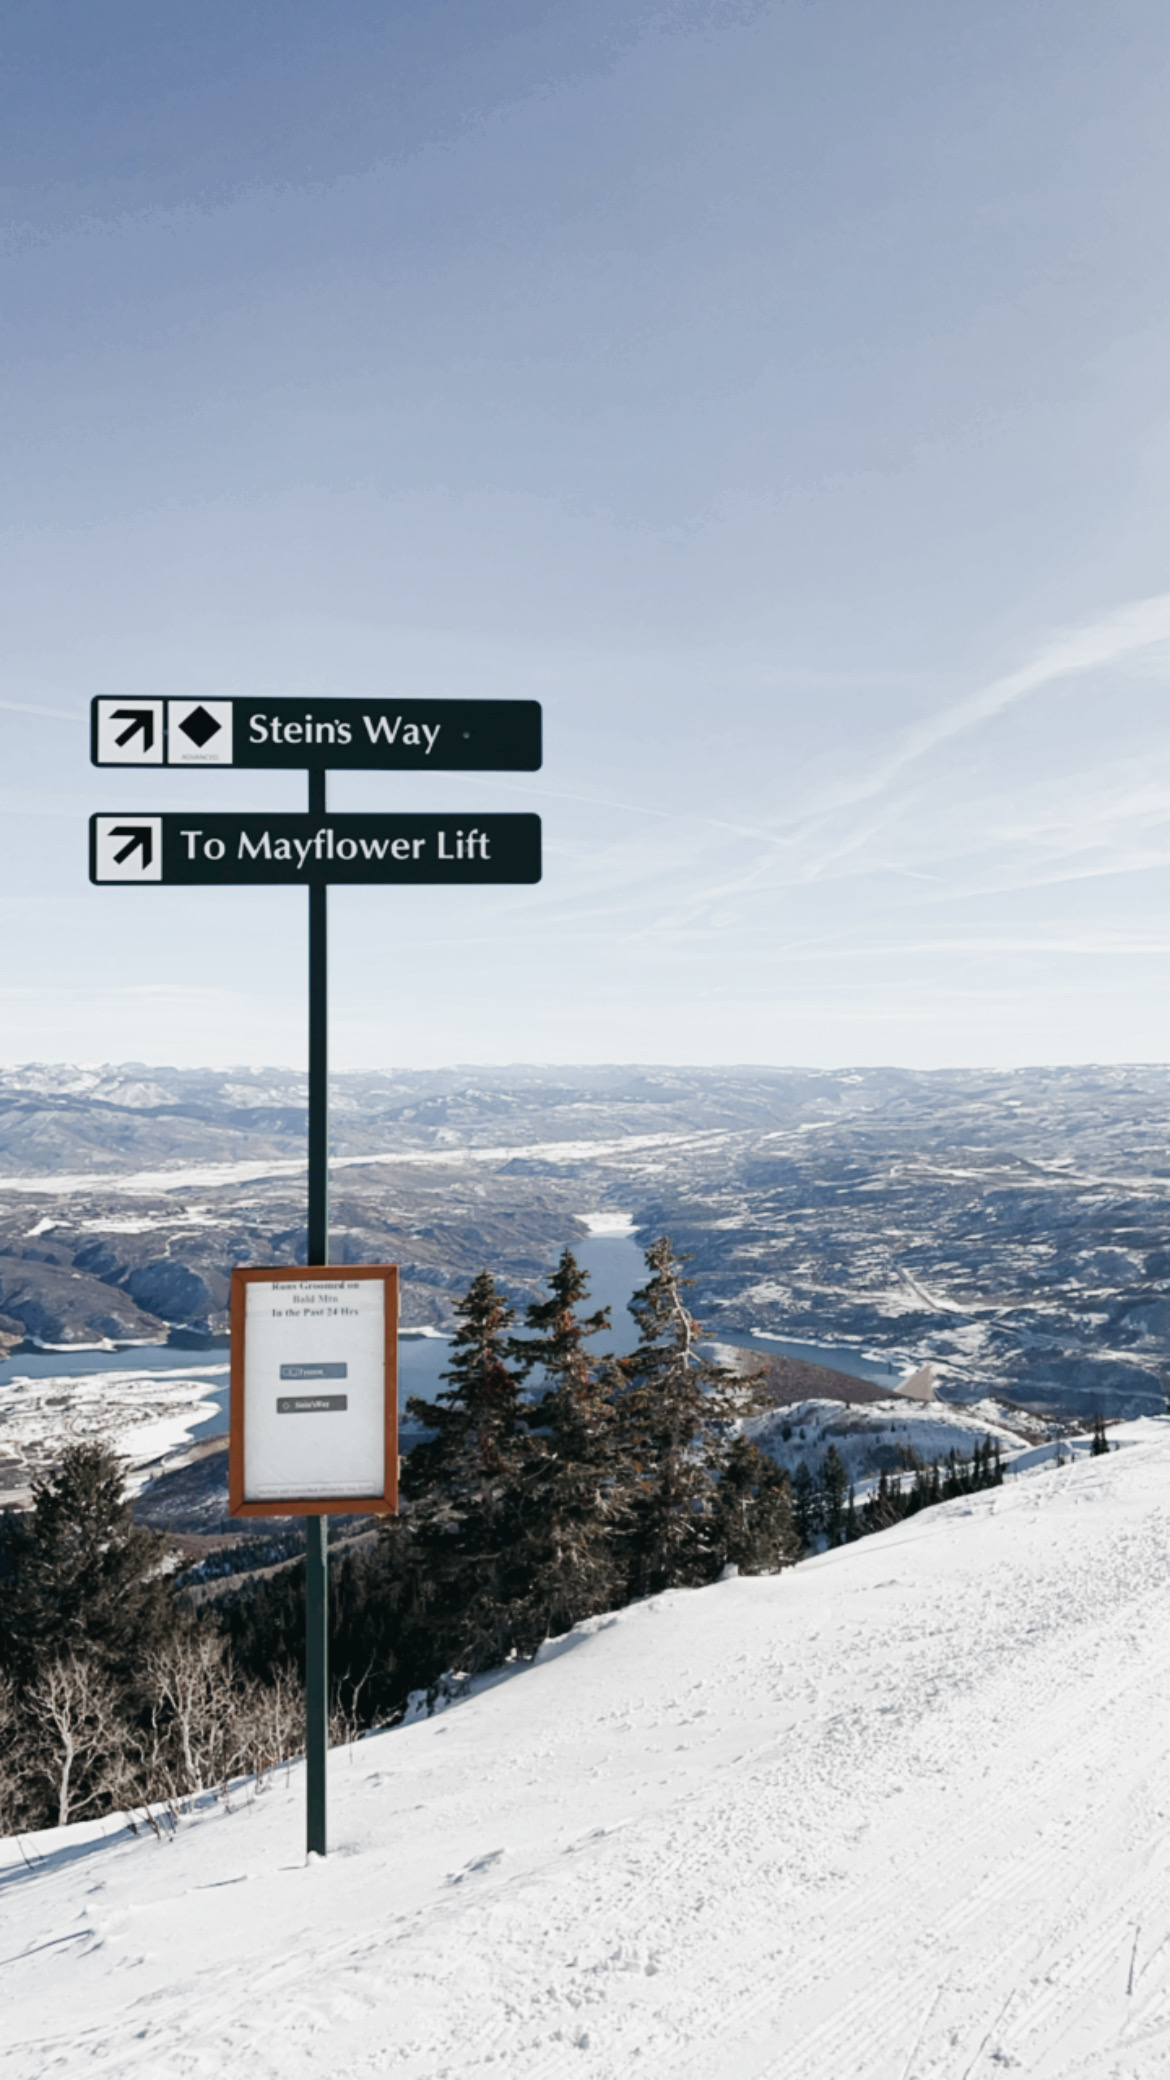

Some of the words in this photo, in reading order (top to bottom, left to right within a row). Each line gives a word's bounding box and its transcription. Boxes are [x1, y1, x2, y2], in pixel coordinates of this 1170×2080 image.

[249, 714, 352, 745] Stein's
[362, 715, 441, 755] Way
[180, 830, 226, 860] To
[237, 829, 426, 869] Mayflower
[437, 828, 491, 860] Lift
[347, 1282, 360, 1290] on
[293, 1295, 315, 1304] Bald
[272, 1309, 282, 1317] In
[285, 1308, 300, 1317] the
[303, 1308, 324, 1317] Past
[327, 1307, 338, 1316] 24
[341, 1306, 359, 1316] Hrs
